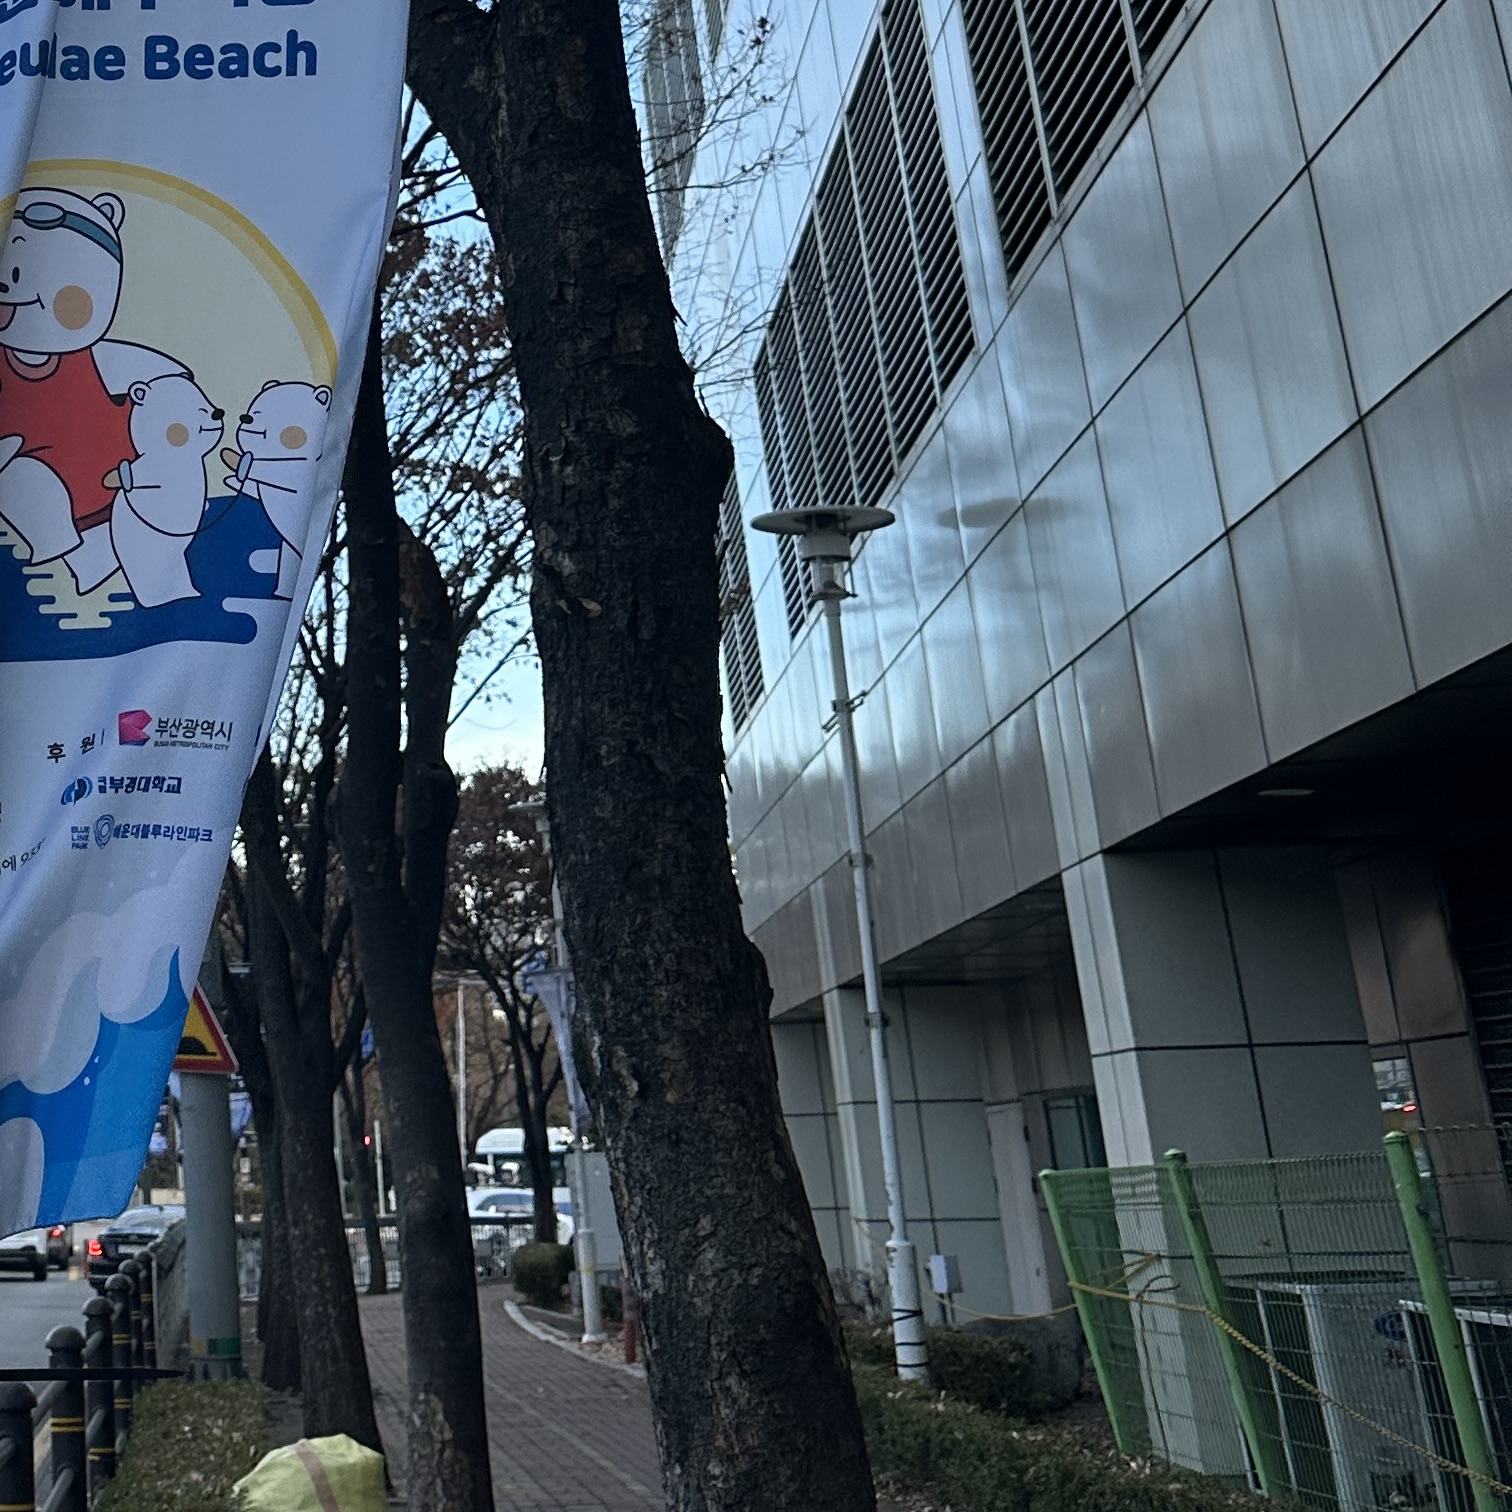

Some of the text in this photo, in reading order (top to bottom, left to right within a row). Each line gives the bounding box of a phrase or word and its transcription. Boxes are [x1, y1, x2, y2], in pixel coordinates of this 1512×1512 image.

[144, 29, 317, 80] Beach
[155, 717, 233, 743] 부산광역시
[109, 775, 183, 794] 부경대학교
